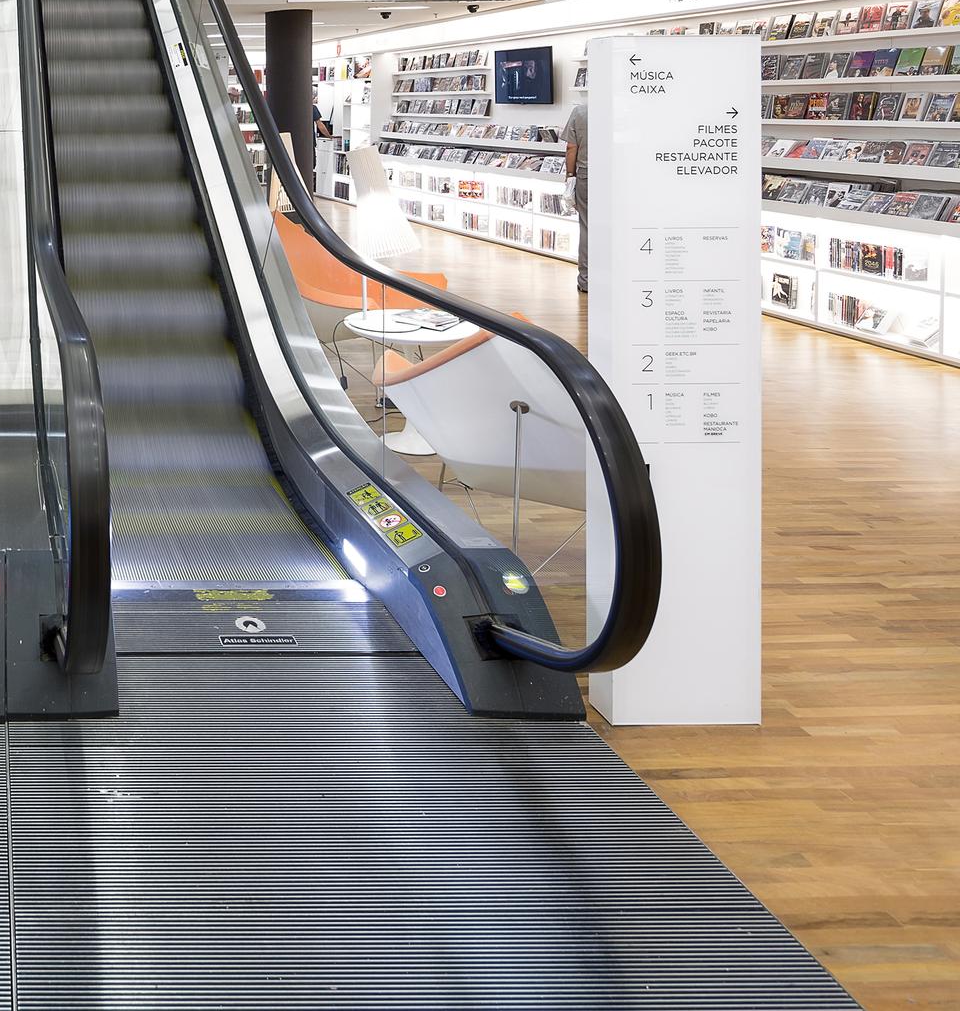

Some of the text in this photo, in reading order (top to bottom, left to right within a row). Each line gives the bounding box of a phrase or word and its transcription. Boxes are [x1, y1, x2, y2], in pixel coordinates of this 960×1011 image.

[630, 69, 674, 81] MÚSICA
[630, 84, 666, 94] CAIXA
[697, 124, 738, 134] FILMES
[693, 138, 738, 148] PACOTE
[655, 152, 738, 162] RESTAURANTE
[676, 165, 738, 175] ELEVADOR
[639, 237, 654, 255] 4
[640, 290, 654, 308] 3
[641, 354, 654, 373] 2
[647, 393, 653, 411] 1
